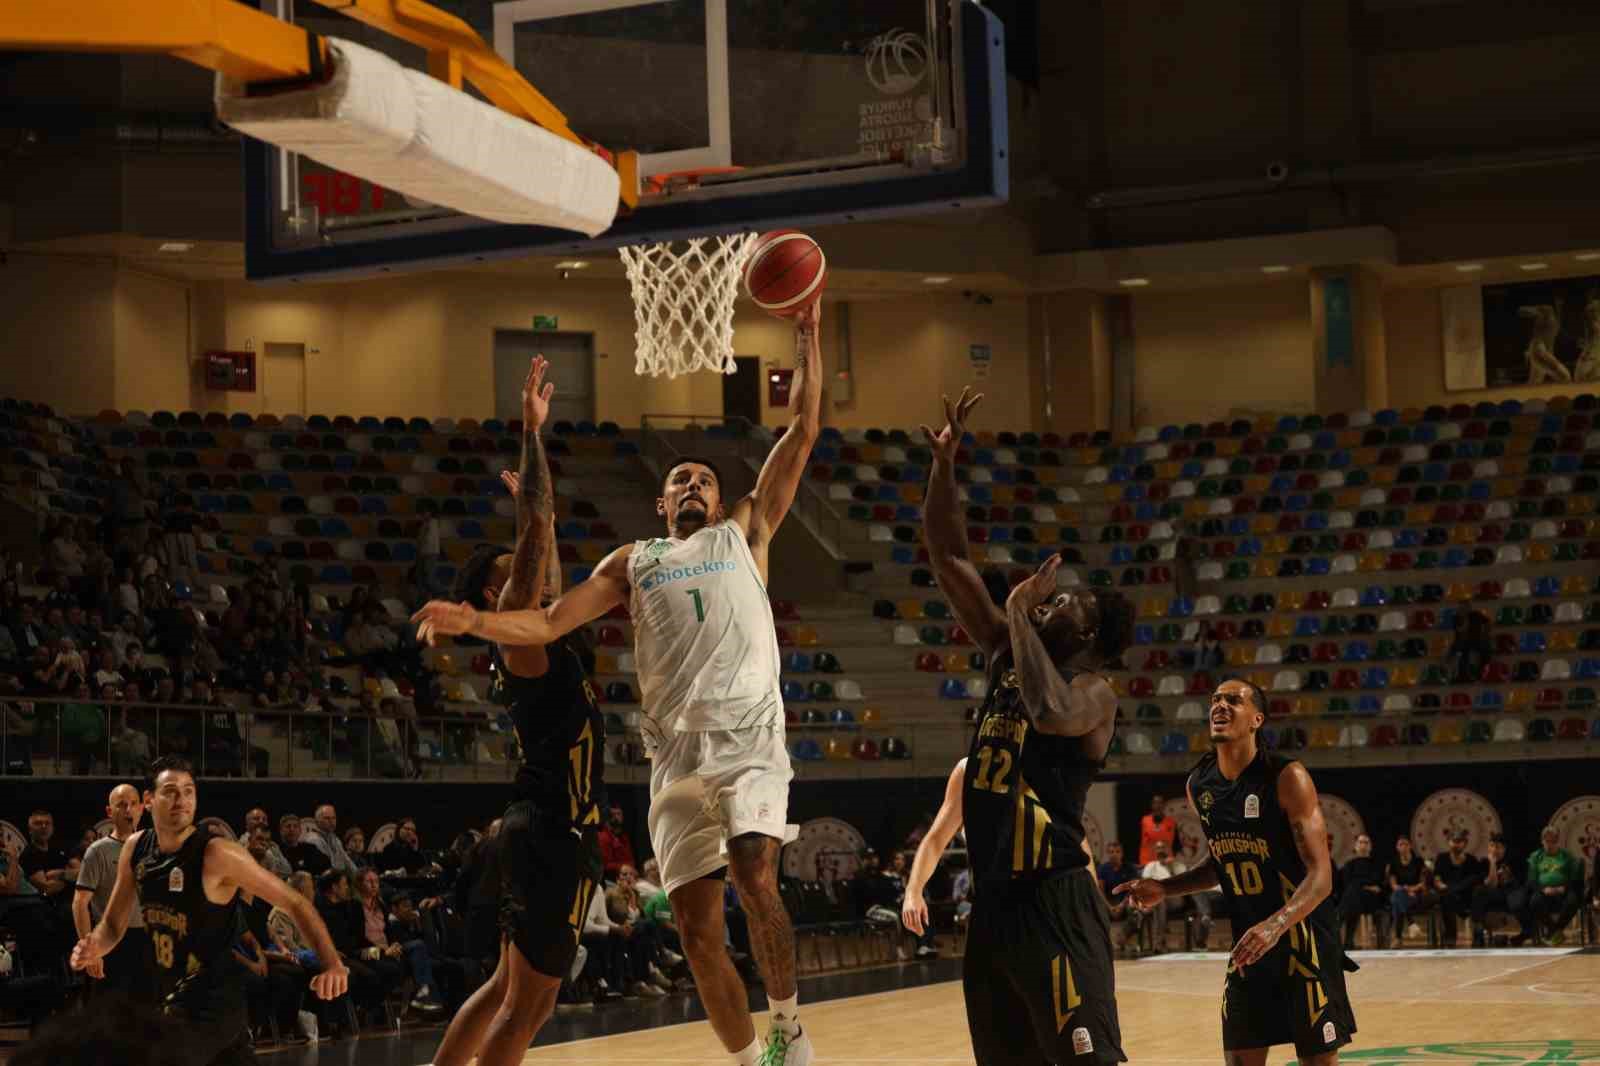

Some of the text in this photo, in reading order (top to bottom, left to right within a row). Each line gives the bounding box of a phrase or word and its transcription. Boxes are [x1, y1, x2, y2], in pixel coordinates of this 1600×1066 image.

[655, 559, 736, 585] biotekno
[685, 588, 704, 622] 1
[973, 746, 1012, 793] 12
[1225, 861, 1264, 895] 10
[152, 930, 174, 968] 18
